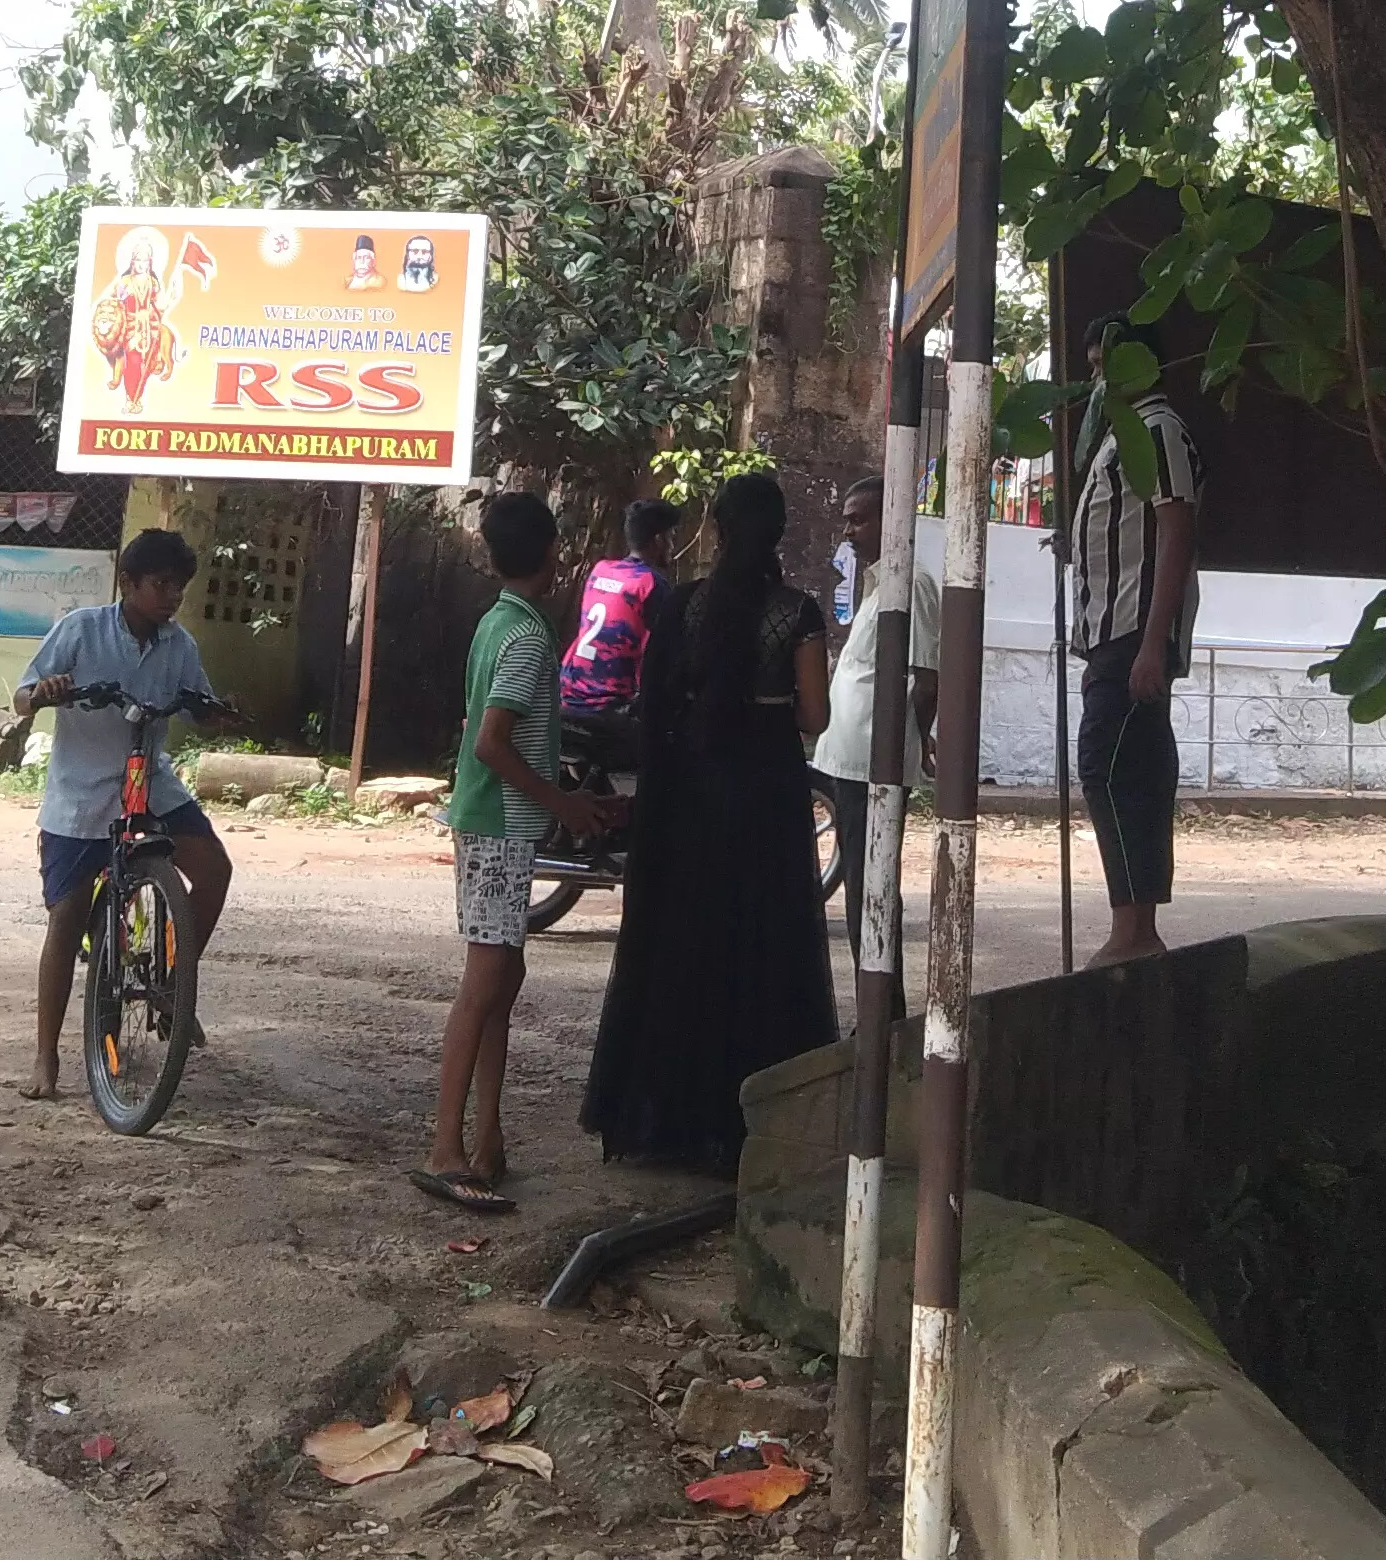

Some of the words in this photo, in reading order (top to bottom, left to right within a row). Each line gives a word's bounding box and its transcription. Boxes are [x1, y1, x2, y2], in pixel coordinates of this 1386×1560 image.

[264, 306, 363, 321] WELCOME
[369, 308, 395, 322] TO
[200, 326, 379, 351] PADMANABHAPURAM
[384, 330, 452, 353] PALACE
[211, 360, 424, 413] RSS
[95, 428, 162, 451] FORT
[168, 429, 438, 460] PADMANABHAPURAM
[575, 602, 606, 661] 2
